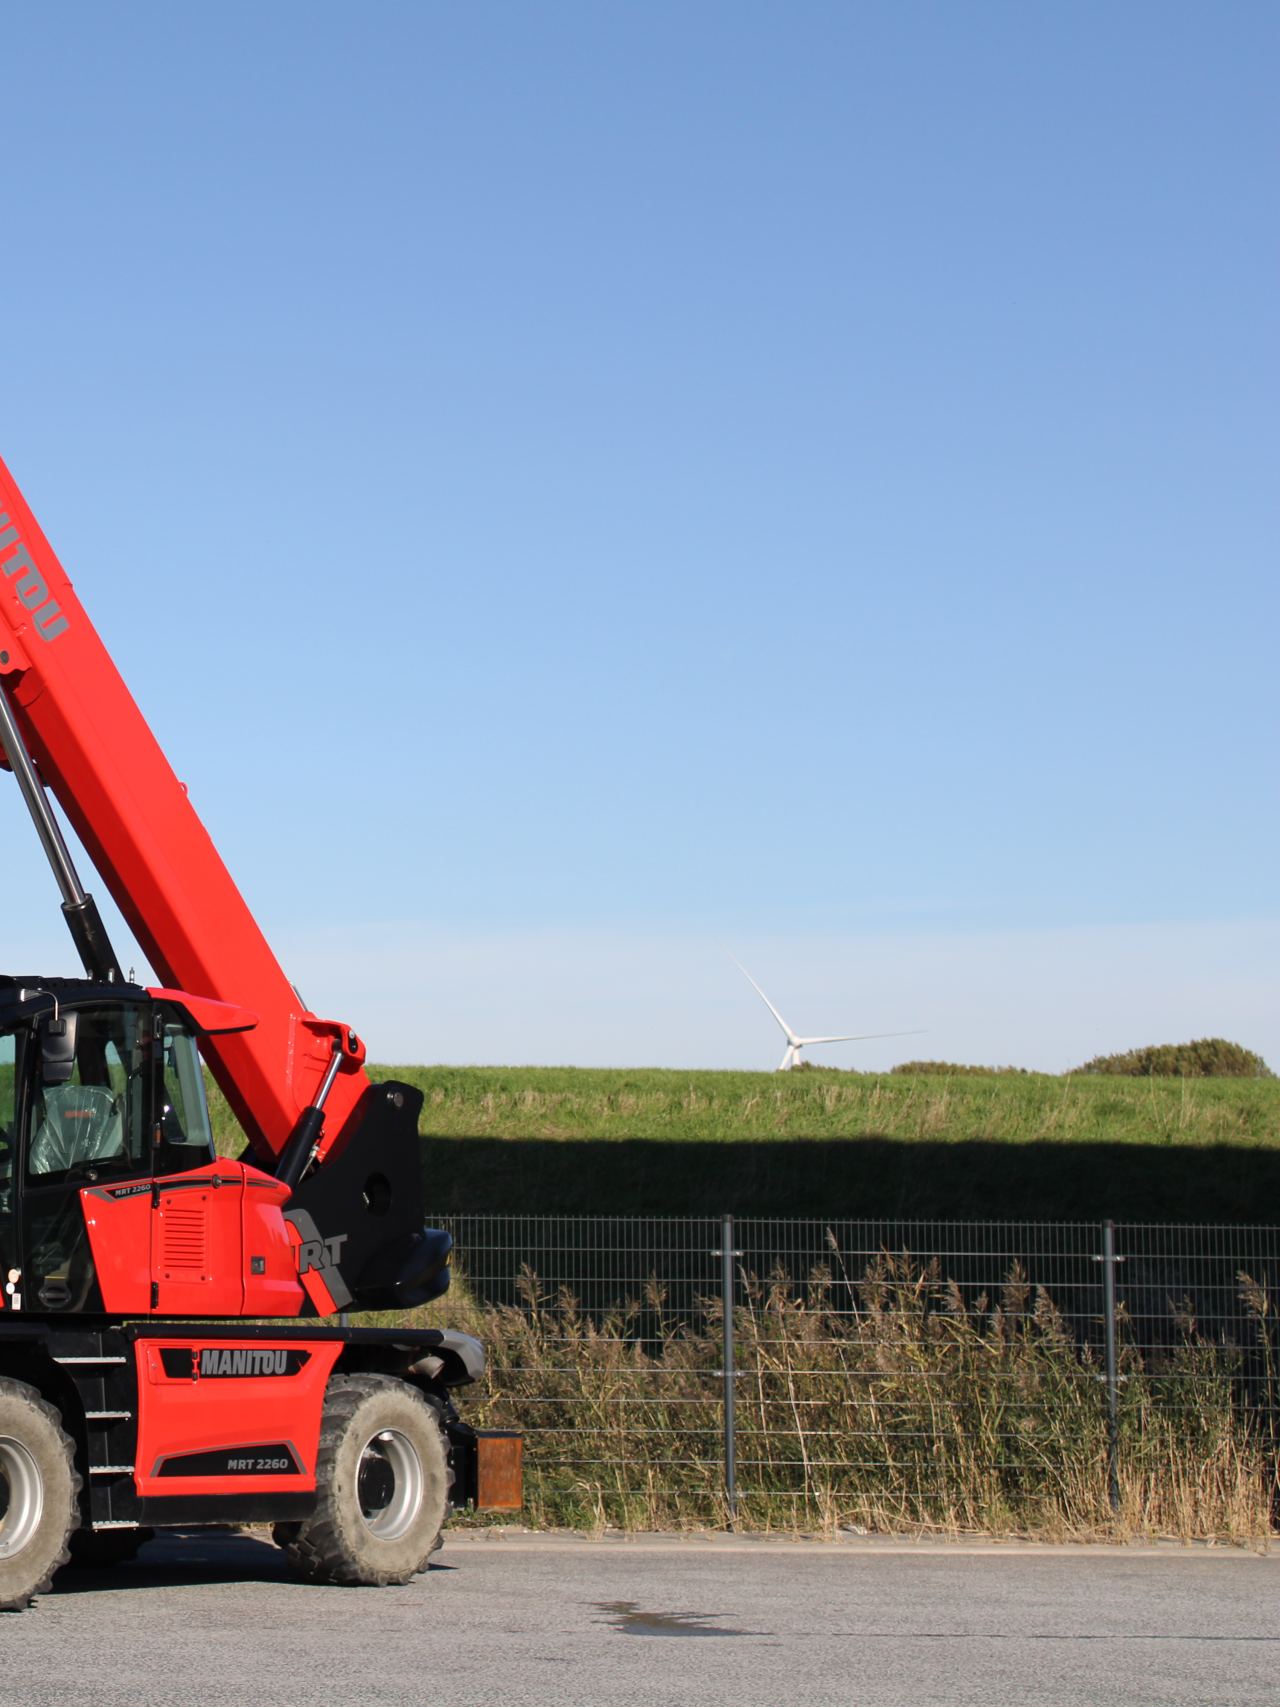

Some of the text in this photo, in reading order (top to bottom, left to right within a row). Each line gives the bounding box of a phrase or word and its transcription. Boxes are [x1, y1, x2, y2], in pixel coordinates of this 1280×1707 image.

[115, 1184, 151, 1196] MRT 2260
[291, 1234, 348, 1274] RT
[201, 1350, 288, 1375] MANITOU
[228, 1459, 288, 1470] MRT 2260
